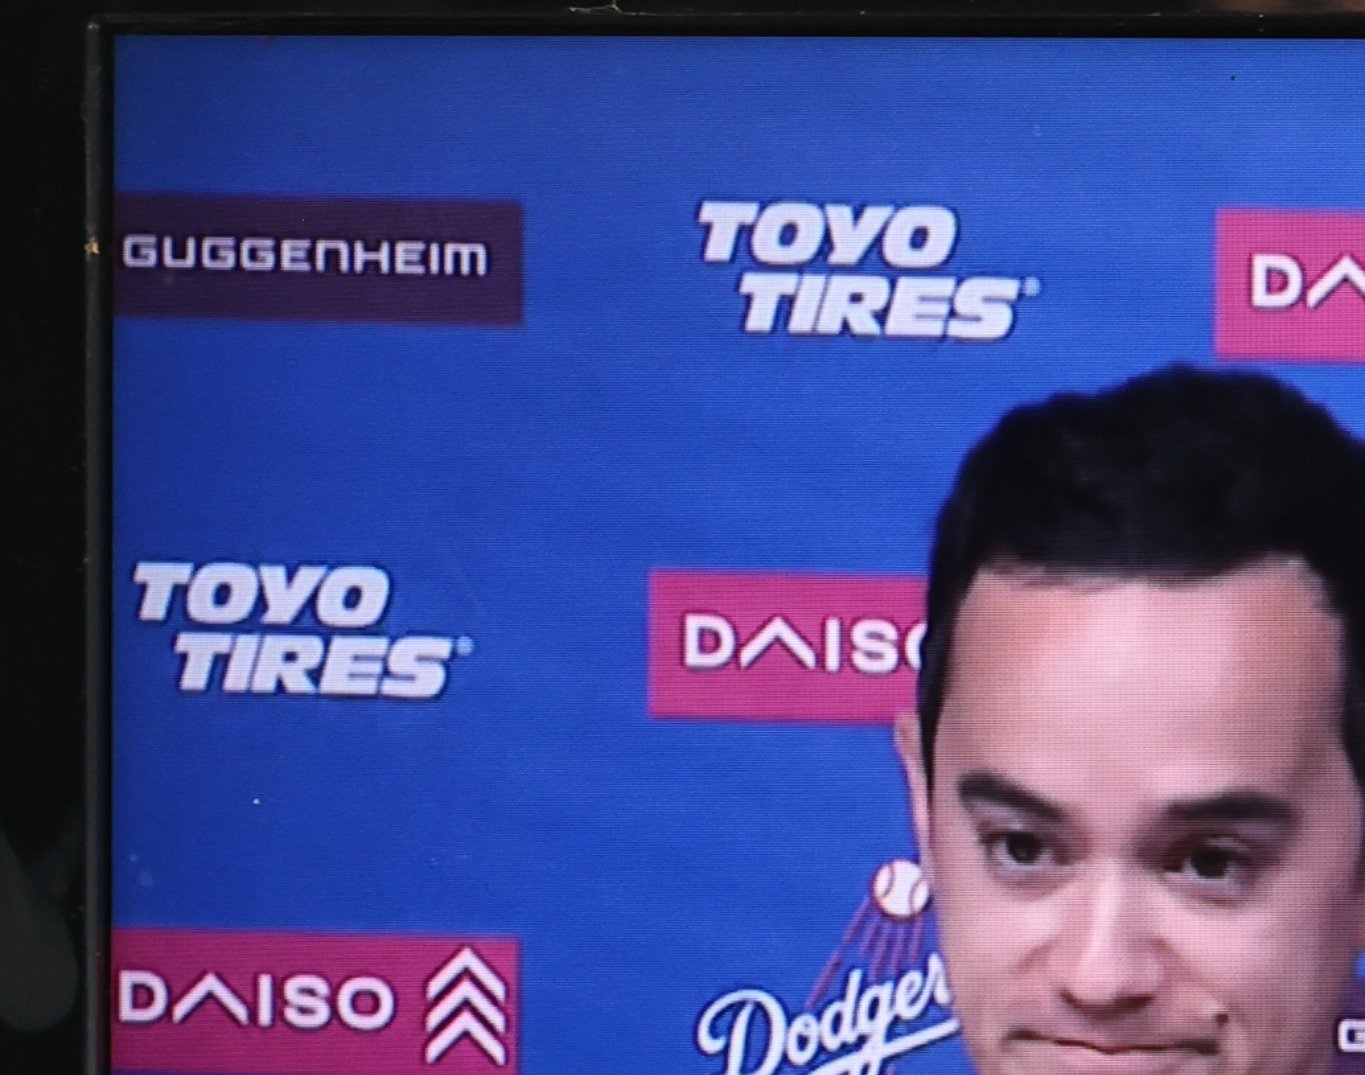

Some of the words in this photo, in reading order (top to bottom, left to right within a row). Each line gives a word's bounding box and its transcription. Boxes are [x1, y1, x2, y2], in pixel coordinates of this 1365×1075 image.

[123, 236, 486, 276] GUGGENHEIM
[696, 200, 958, 269] TOYO
[132, 562, 390, 625] TOYO
[120, 971, 394, 1030] DAISO
